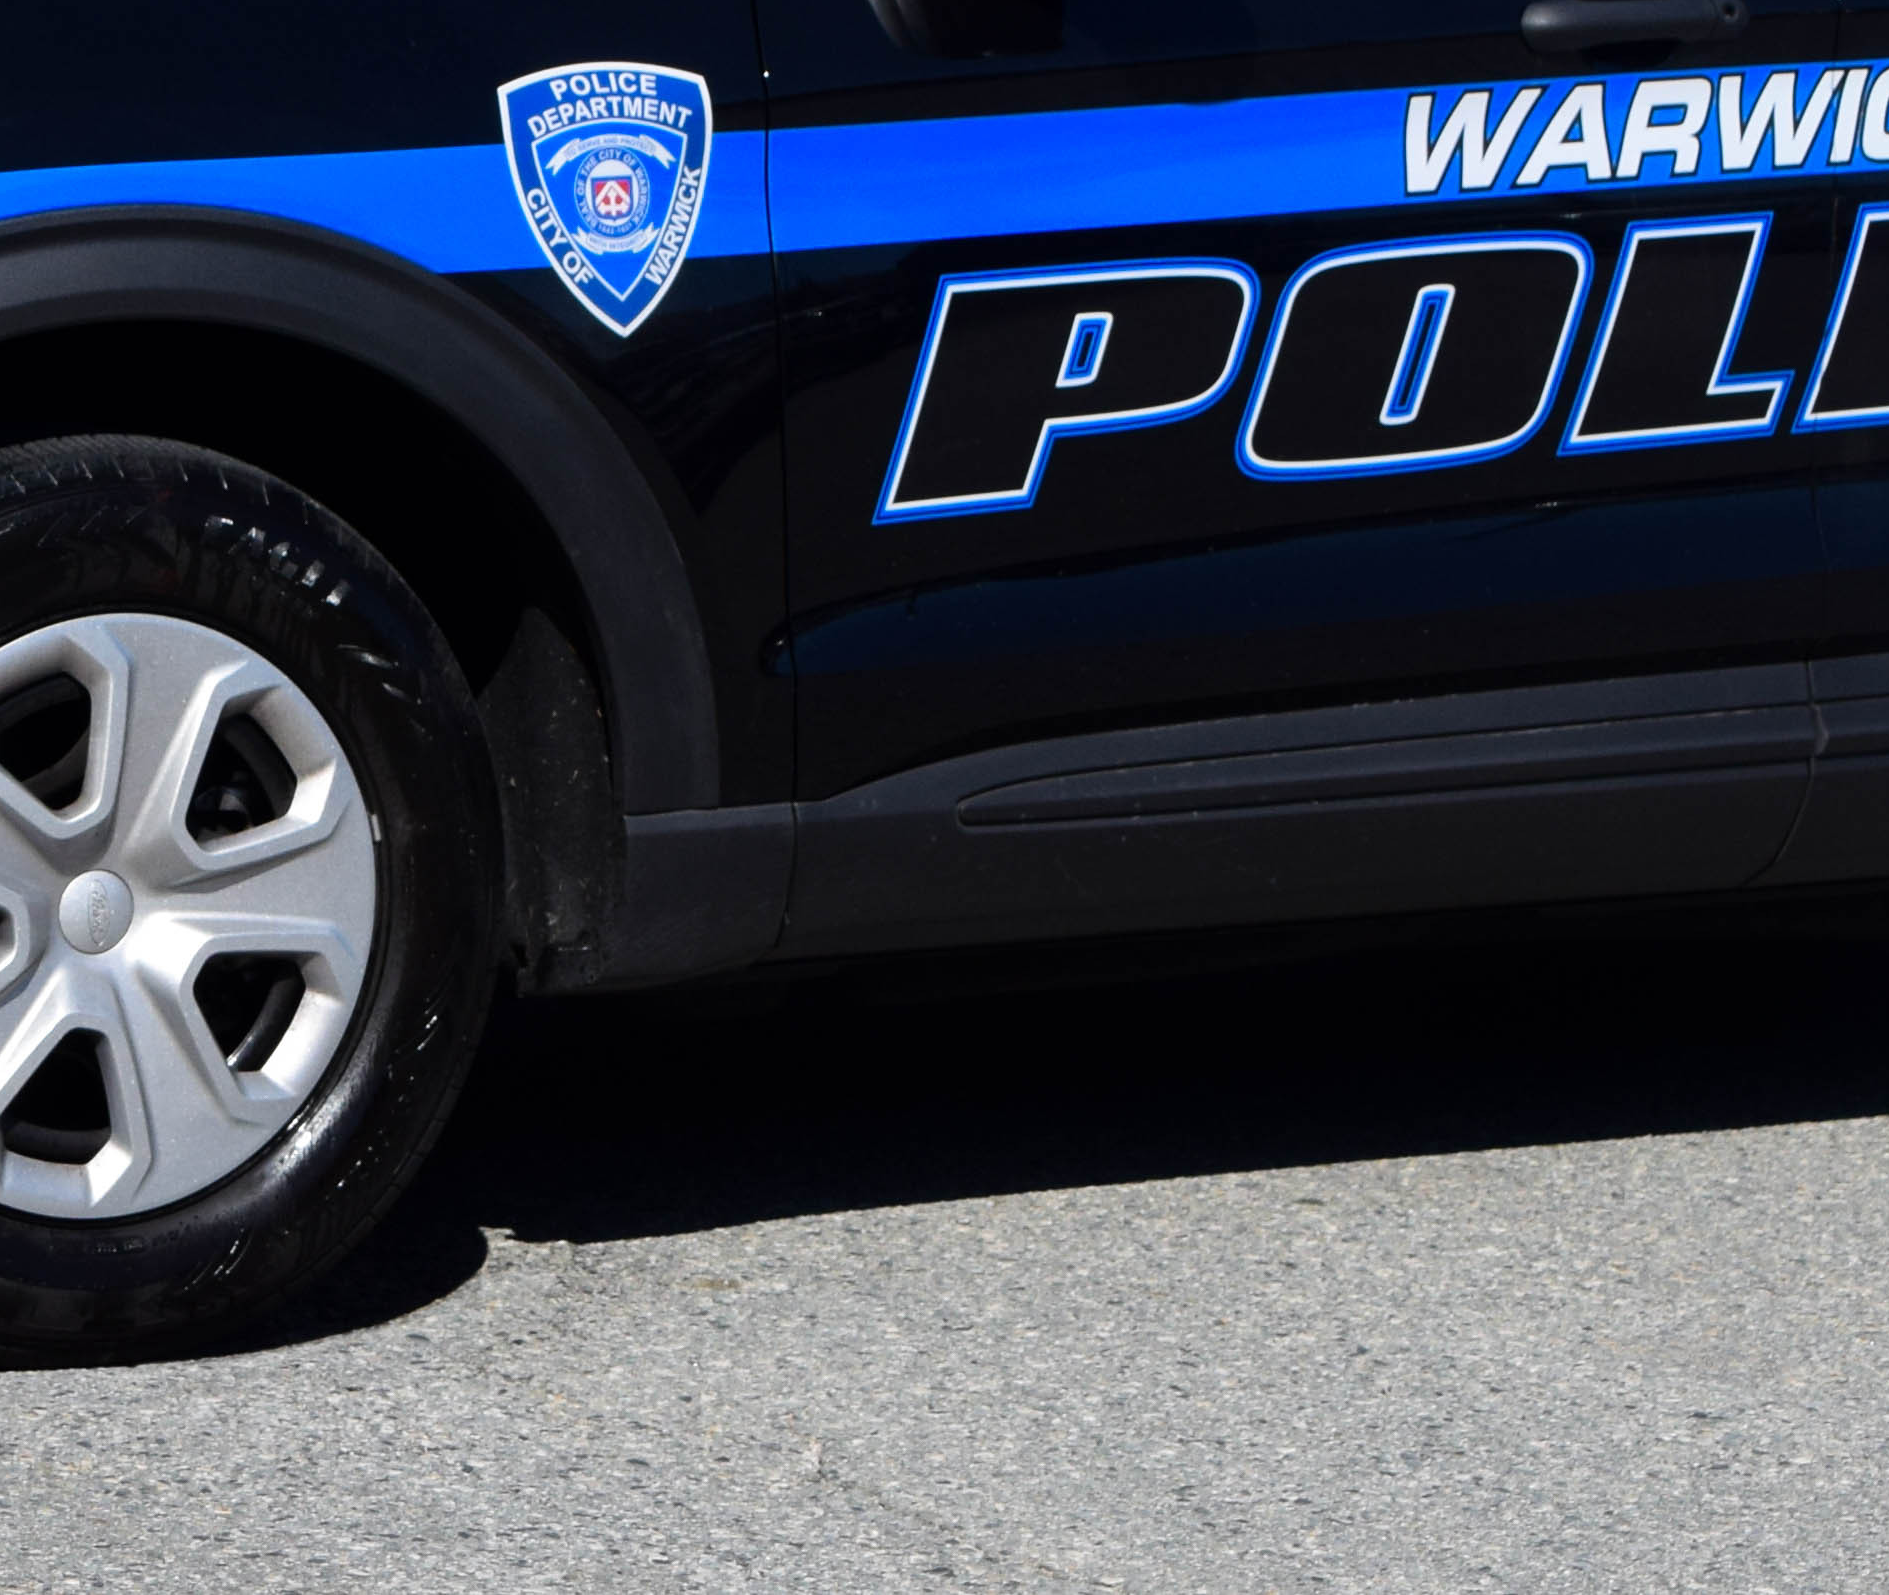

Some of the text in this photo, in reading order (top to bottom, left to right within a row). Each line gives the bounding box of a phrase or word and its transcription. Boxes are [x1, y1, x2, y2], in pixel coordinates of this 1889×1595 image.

[527, 96, 693, 138] DEPARTMENT
[549, 72, 658, 101] POLICE
[526, 187, 595, 284] CITY OF
[644, 165, 702, 286] WARWICK
